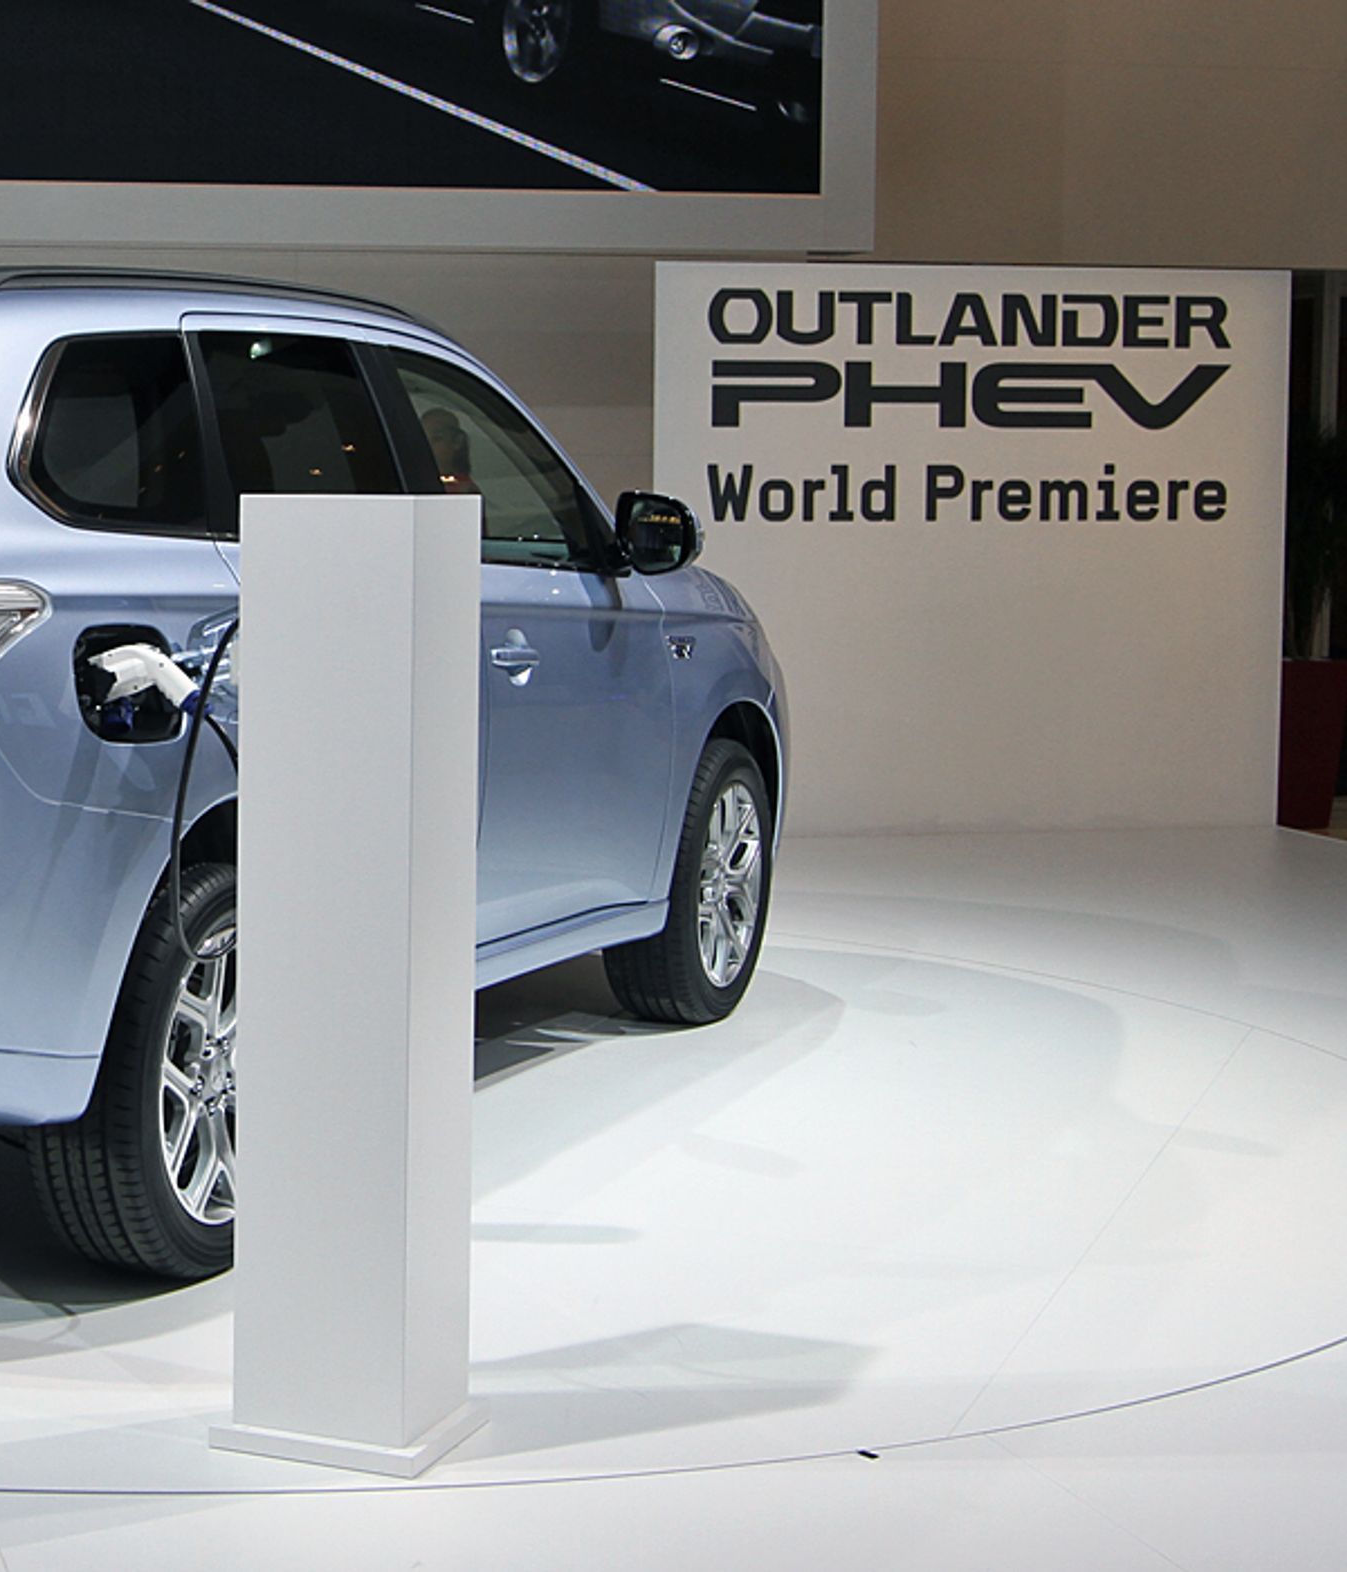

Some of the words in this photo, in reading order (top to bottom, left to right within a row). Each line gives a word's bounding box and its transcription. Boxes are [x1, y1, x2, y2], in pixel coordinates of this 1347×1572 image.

[708, 288, 1232, 349] OUTLANDER
[711, 360, 1232, 430] PHEV
[707, 463, 897, 523] World
[925, 463, 1228, 523] Premiere
